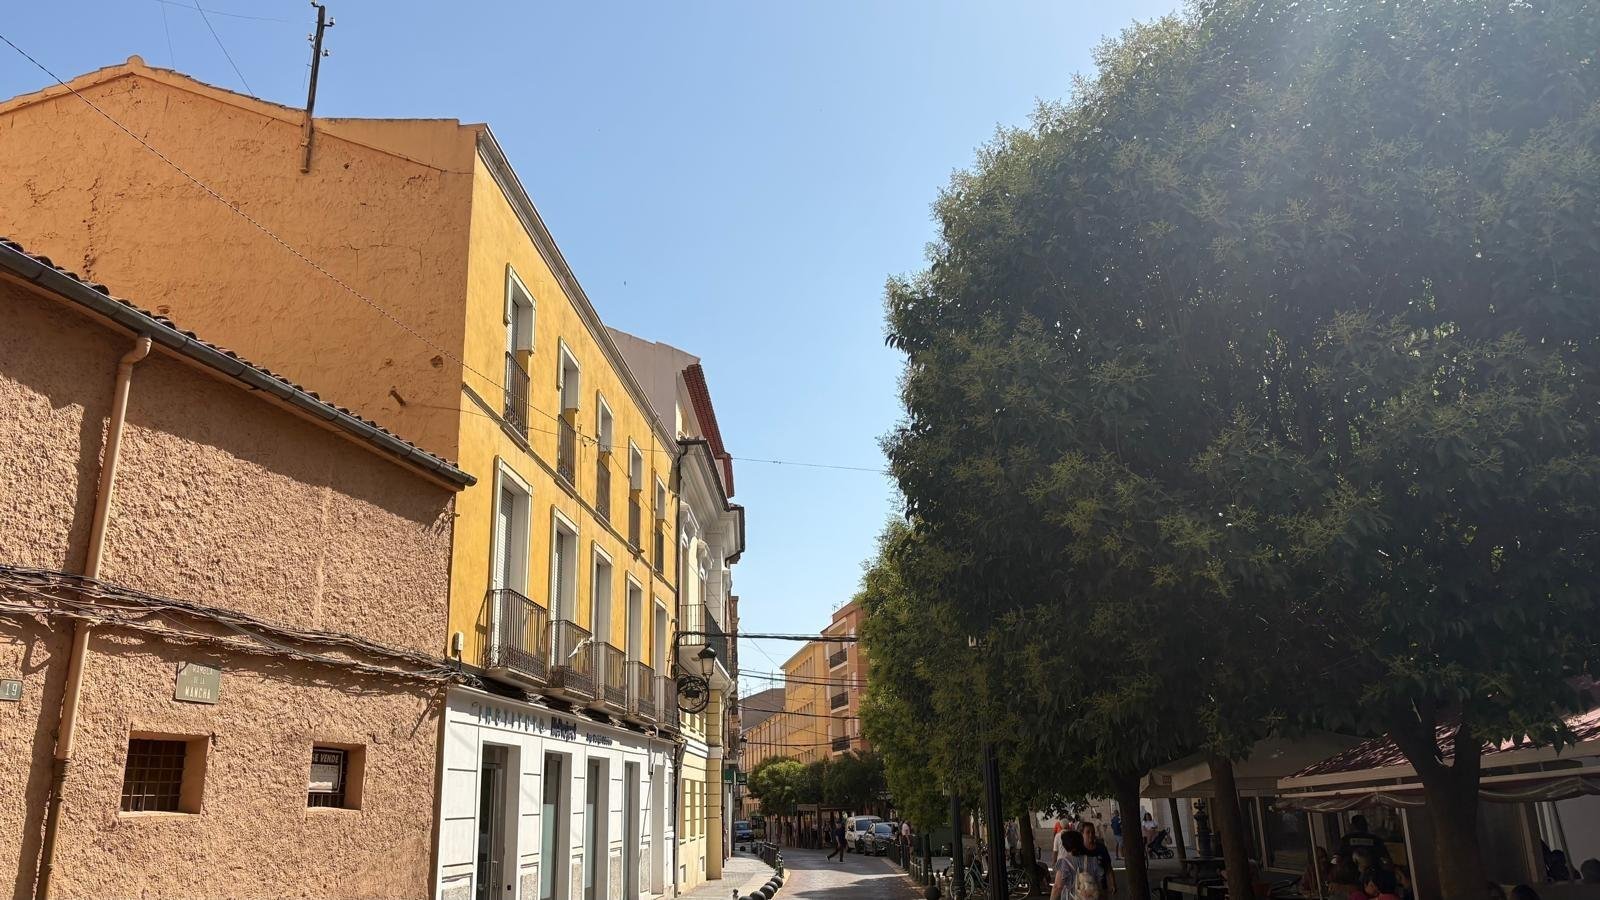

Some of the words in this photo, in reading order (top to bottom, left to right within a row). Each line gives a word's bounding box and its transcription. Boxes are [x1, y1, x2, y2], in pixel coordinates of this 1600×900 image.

[5, 682, 18, 696] 19
[185, 685, 210, 699] MANCHA
[320, 753, 339, 764] VENDE
